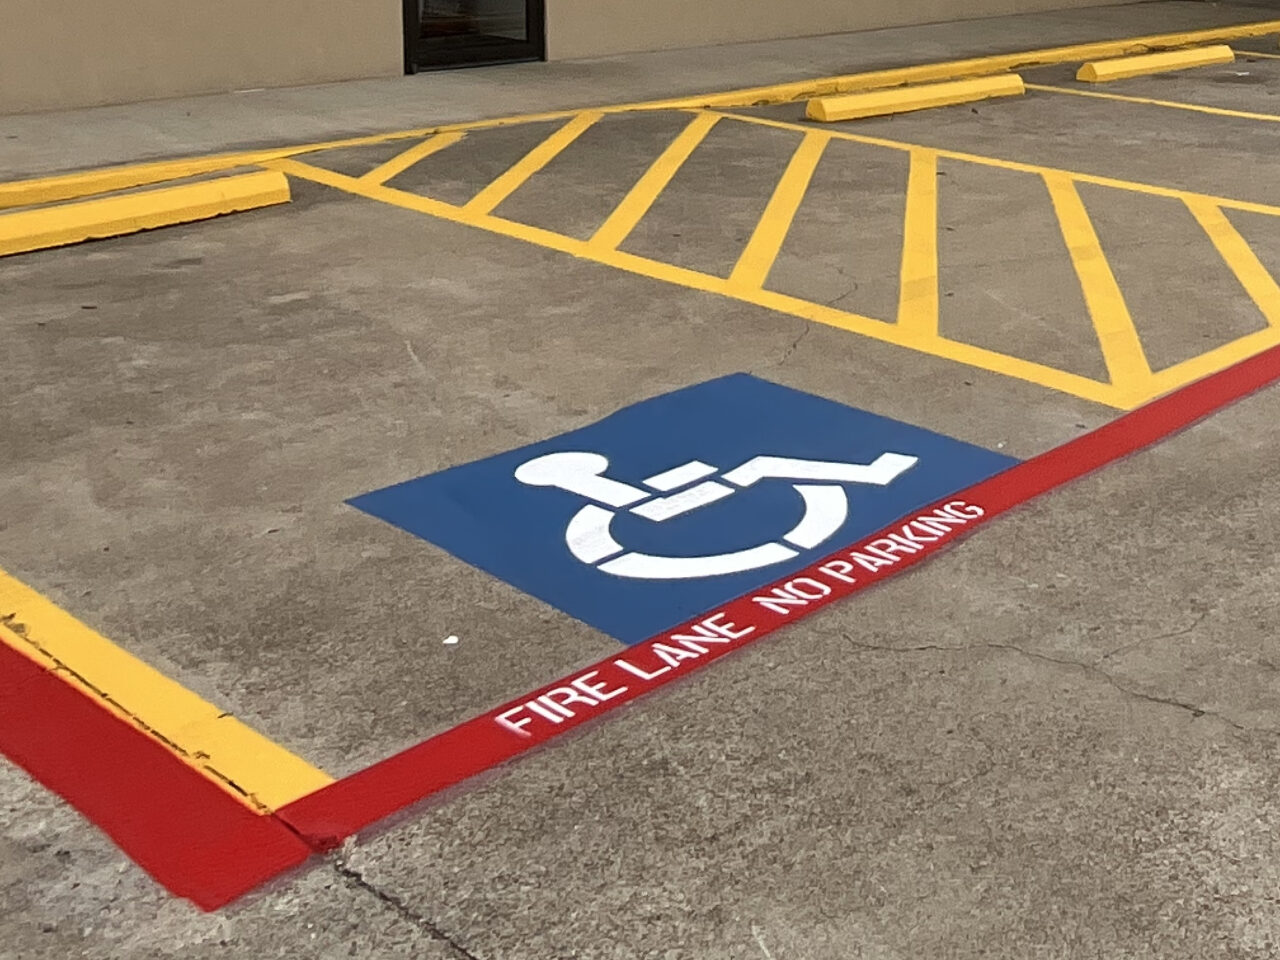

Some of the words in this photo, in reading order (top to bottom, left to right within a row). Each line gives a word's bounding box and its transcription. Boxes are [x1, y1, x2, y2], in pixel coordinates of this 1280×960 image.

[494, 670, 628, 739] FIRE
[616, 613, 756, 681] LANE
[752, 566, 831, 617] NO
[819, 499, 987, 585] PARKING
